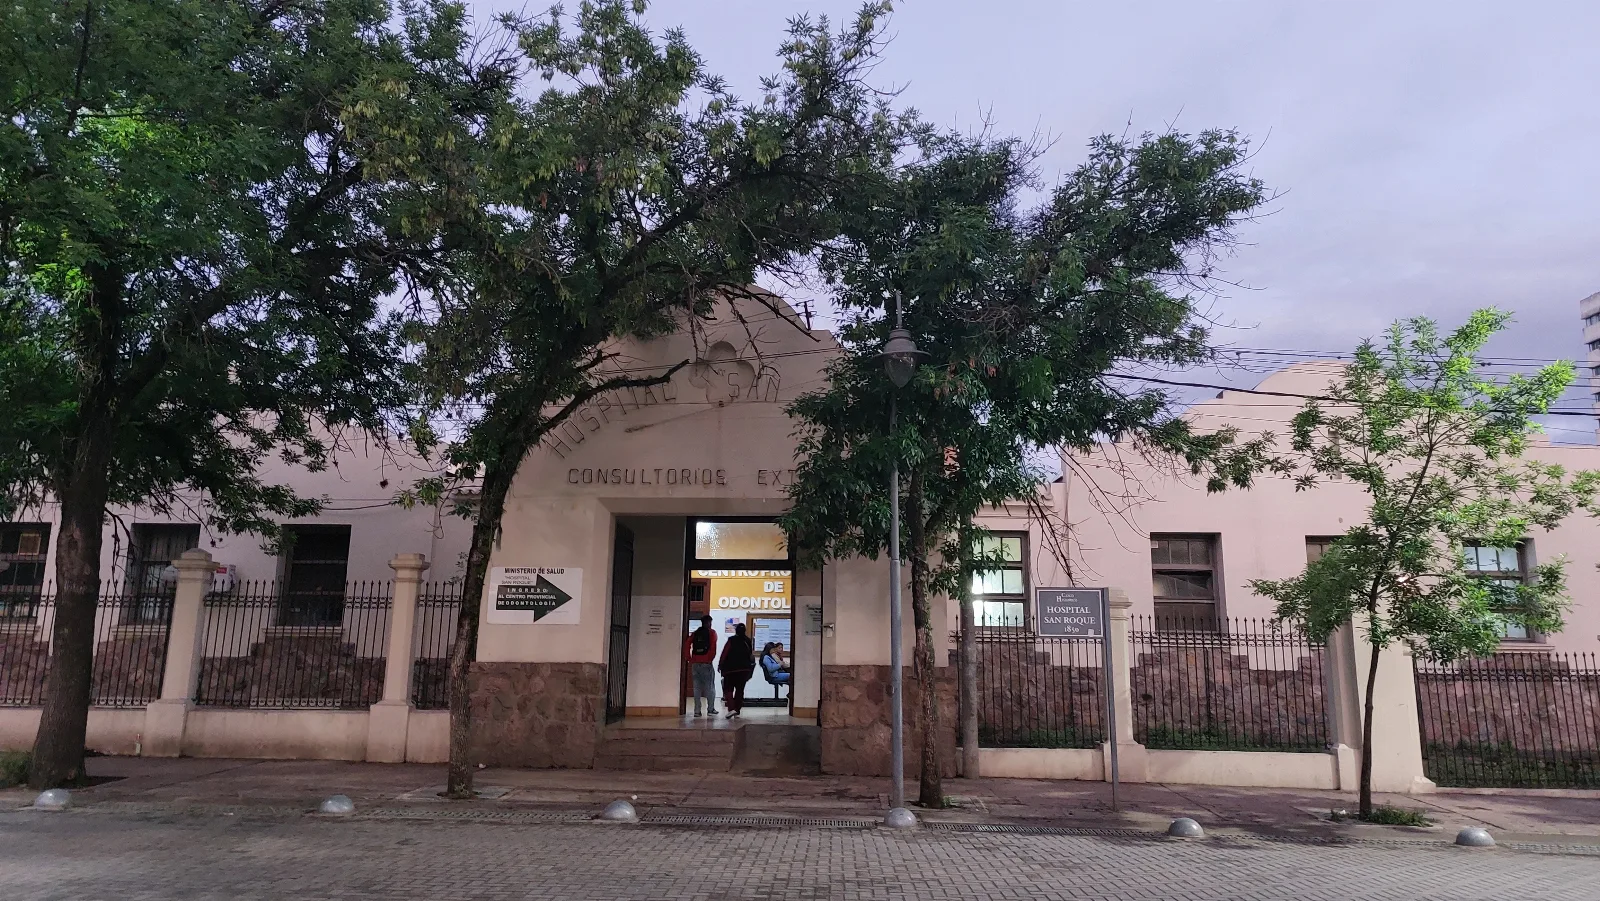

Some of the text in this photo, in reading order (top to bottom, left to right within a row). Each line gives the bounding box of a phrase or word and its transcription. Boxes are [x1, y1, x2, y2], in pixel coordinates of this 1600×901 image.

[568, 468, 727, 486] CONSULTORIOS
[763, 581, 784, 593] DE
[1046, 606, 1091, 614] HOSPITAL
[1044, 616, 1096, 625] SAN ROQUE
